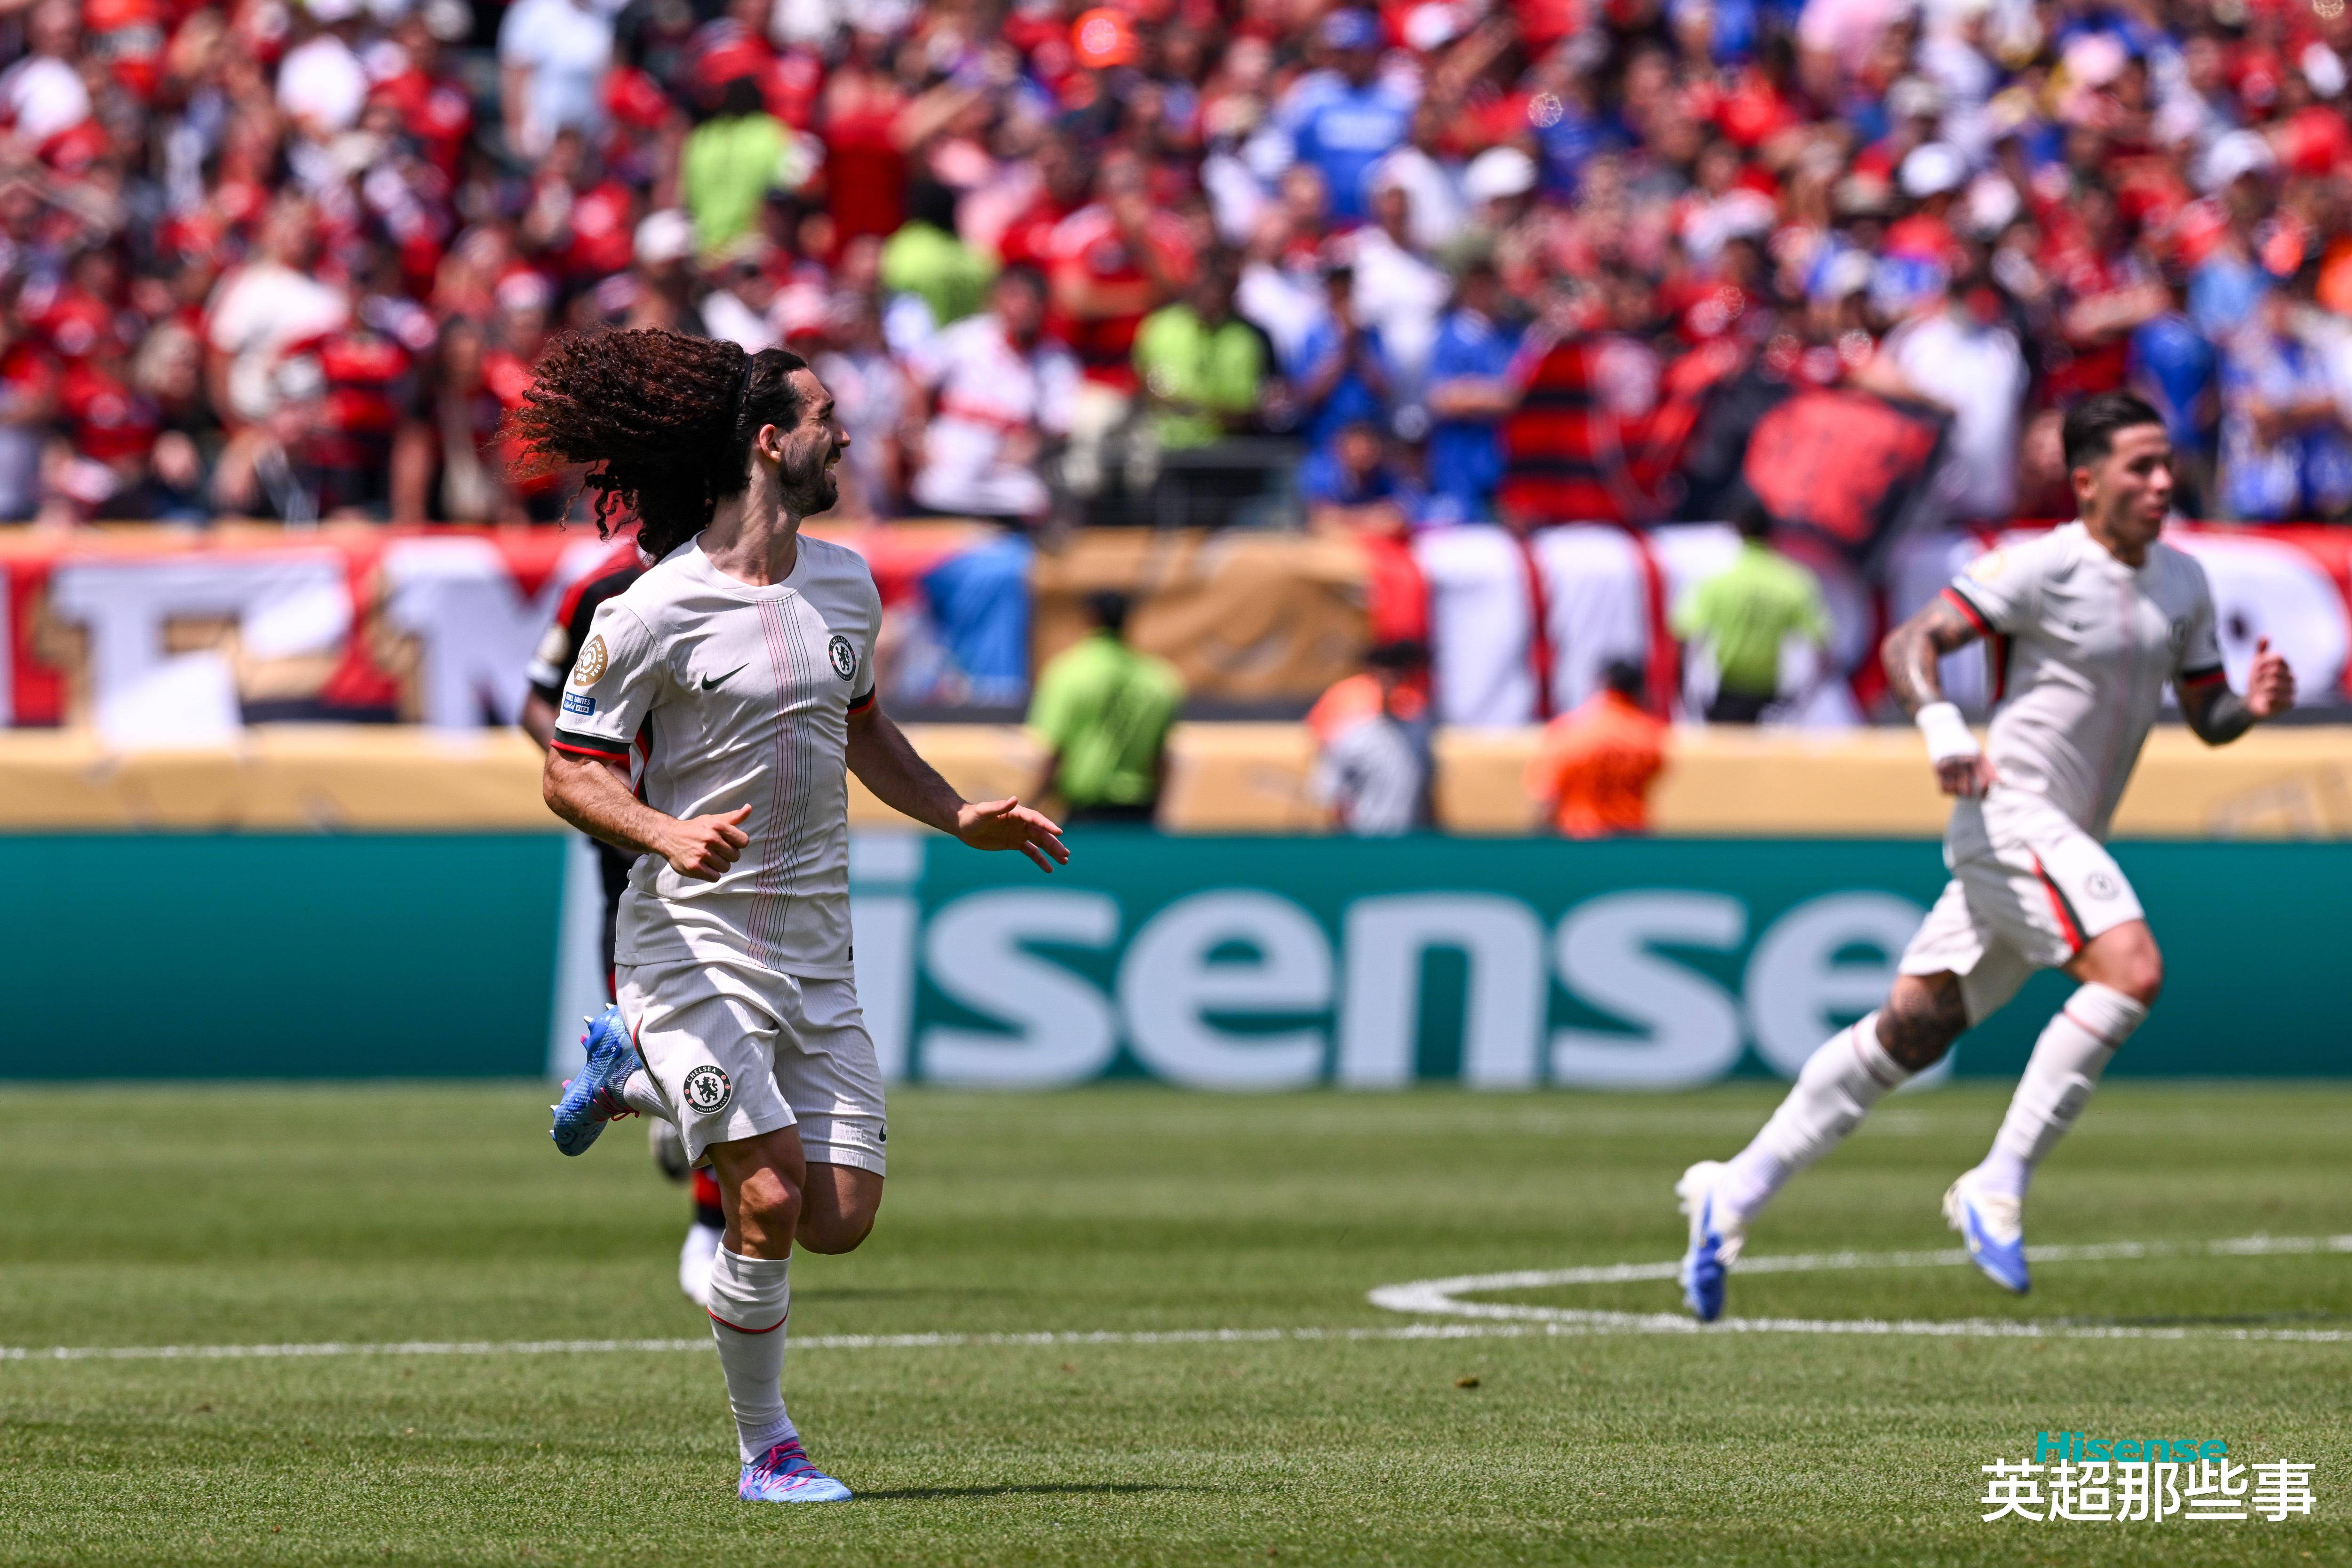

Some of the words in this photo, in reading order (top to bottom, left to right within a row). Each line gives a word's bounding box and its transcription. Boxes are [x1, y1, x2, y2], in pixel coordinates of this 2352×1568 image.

[830, 637, 849, 646] CHELSEA
[590, 664, 602, 677] USA
[573, 696, 591, 706] UNITES
[547, 835, 1959, 1089] isense
[686, 1066, 716, 1082] CHELSEA
[719, 1096, 728, 1106] CLUB
